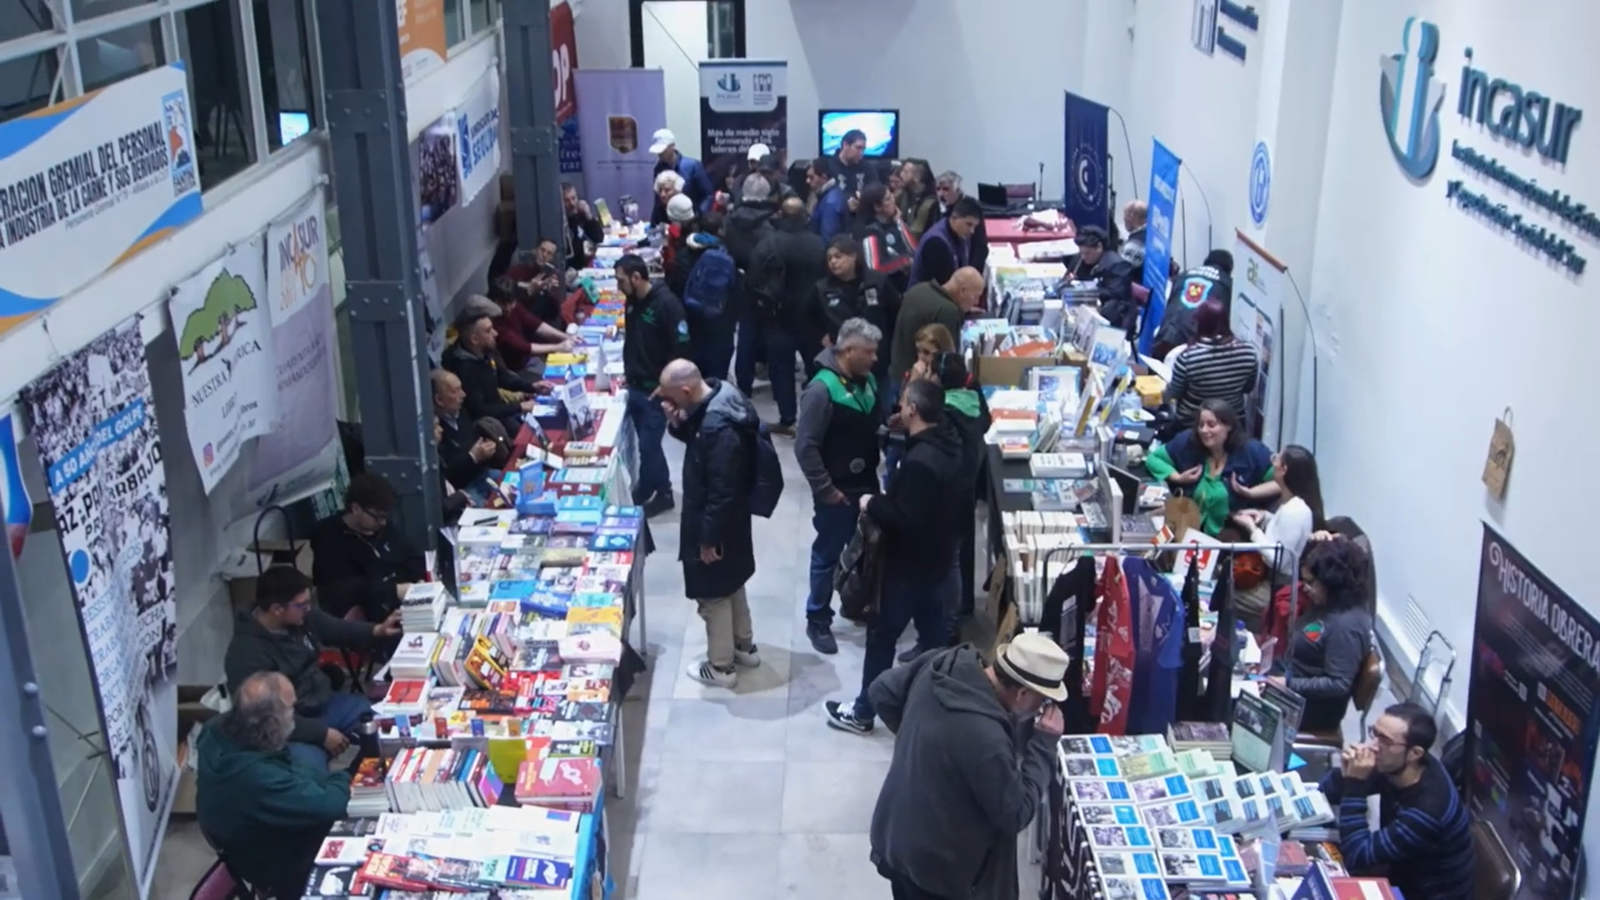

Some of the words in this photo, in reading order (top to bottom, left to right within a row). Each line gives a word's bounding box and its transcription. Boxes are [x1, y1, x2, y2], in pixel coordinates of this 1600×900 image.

[1457, 47, 1583, 166] incasur
[0, 171, 48, 222] RACION
[48, 149, 98, 198] GREMIAL
[98, 141, 118, 173] DEL
[118, 119, 166, 165] PERSONAL
[56, 195, 70, 220] DE
[68, 189, 81, 214] LA
[1499, 558, 1550, 627] HISTORIA
